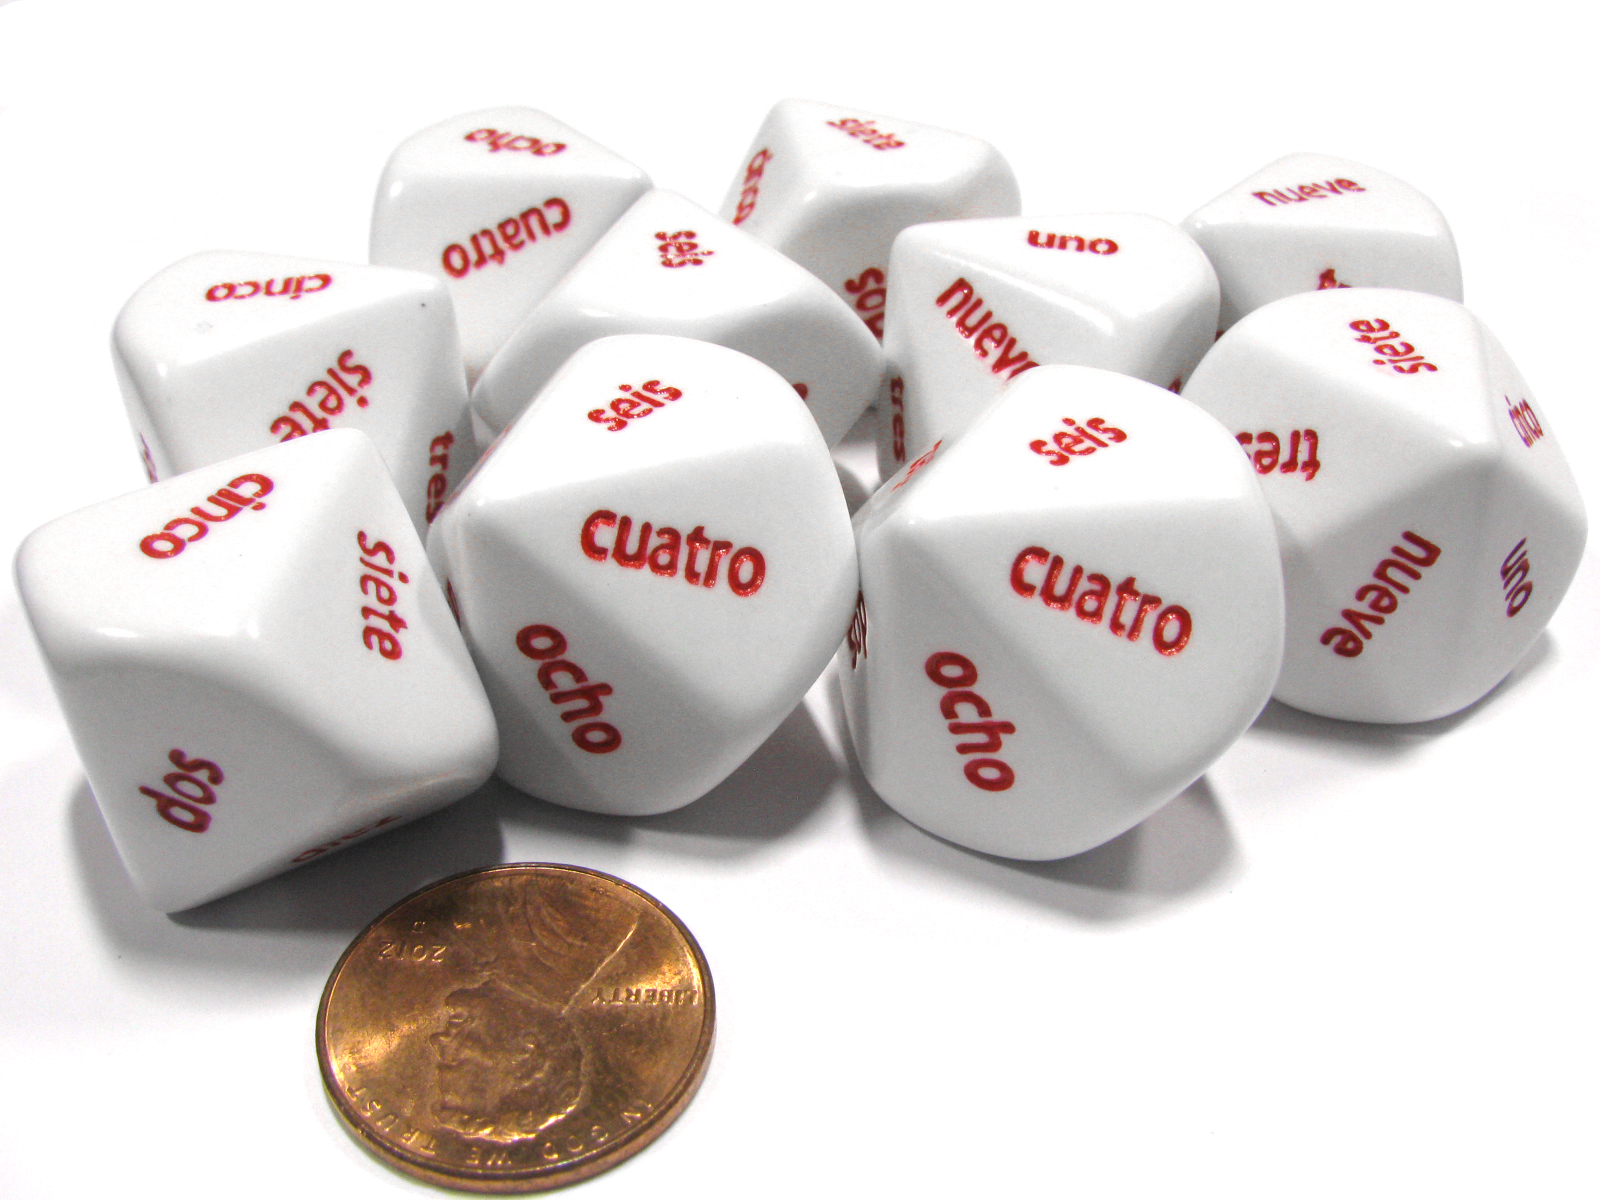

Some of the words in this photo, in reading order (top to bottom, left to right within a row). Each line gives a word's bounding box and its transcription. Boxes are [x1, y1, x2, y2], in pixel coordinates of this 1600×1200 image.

[464, 128, 567, 157] ocho
[826, 117, 906, 151] siete
[1252, 178, 1367, 207] nueve
[441, 197, 573, 280] cuatro
[653, 230, 715, 269] seis
[1026, 229, 1120, 256] uno
[205, 273, 334, 303] cinco
[934, 277, 1040, 381] nuev
[1348, 317, 1439, 375] siete
[587, 379, 684, 433] seis
[1028, 416, 1128, 467] seis
[139, 472, 275, 560] cinco
[580, 509, 768, 599] cuatro
[1500, 537, 1533, 618] uno
[357, 529, 411, 662] siete
[1009, 545, 1193, 659] cuatro
[1320, 530, 1442, 658] nueve
[516, 623, 623, 755] ocho
[924, 650, 1017, 793] ocho
[139, 749, 225, 834] dos
[378, 943, 447, 963] 2012
[592, 987, 699, 1006] LIBERTY
